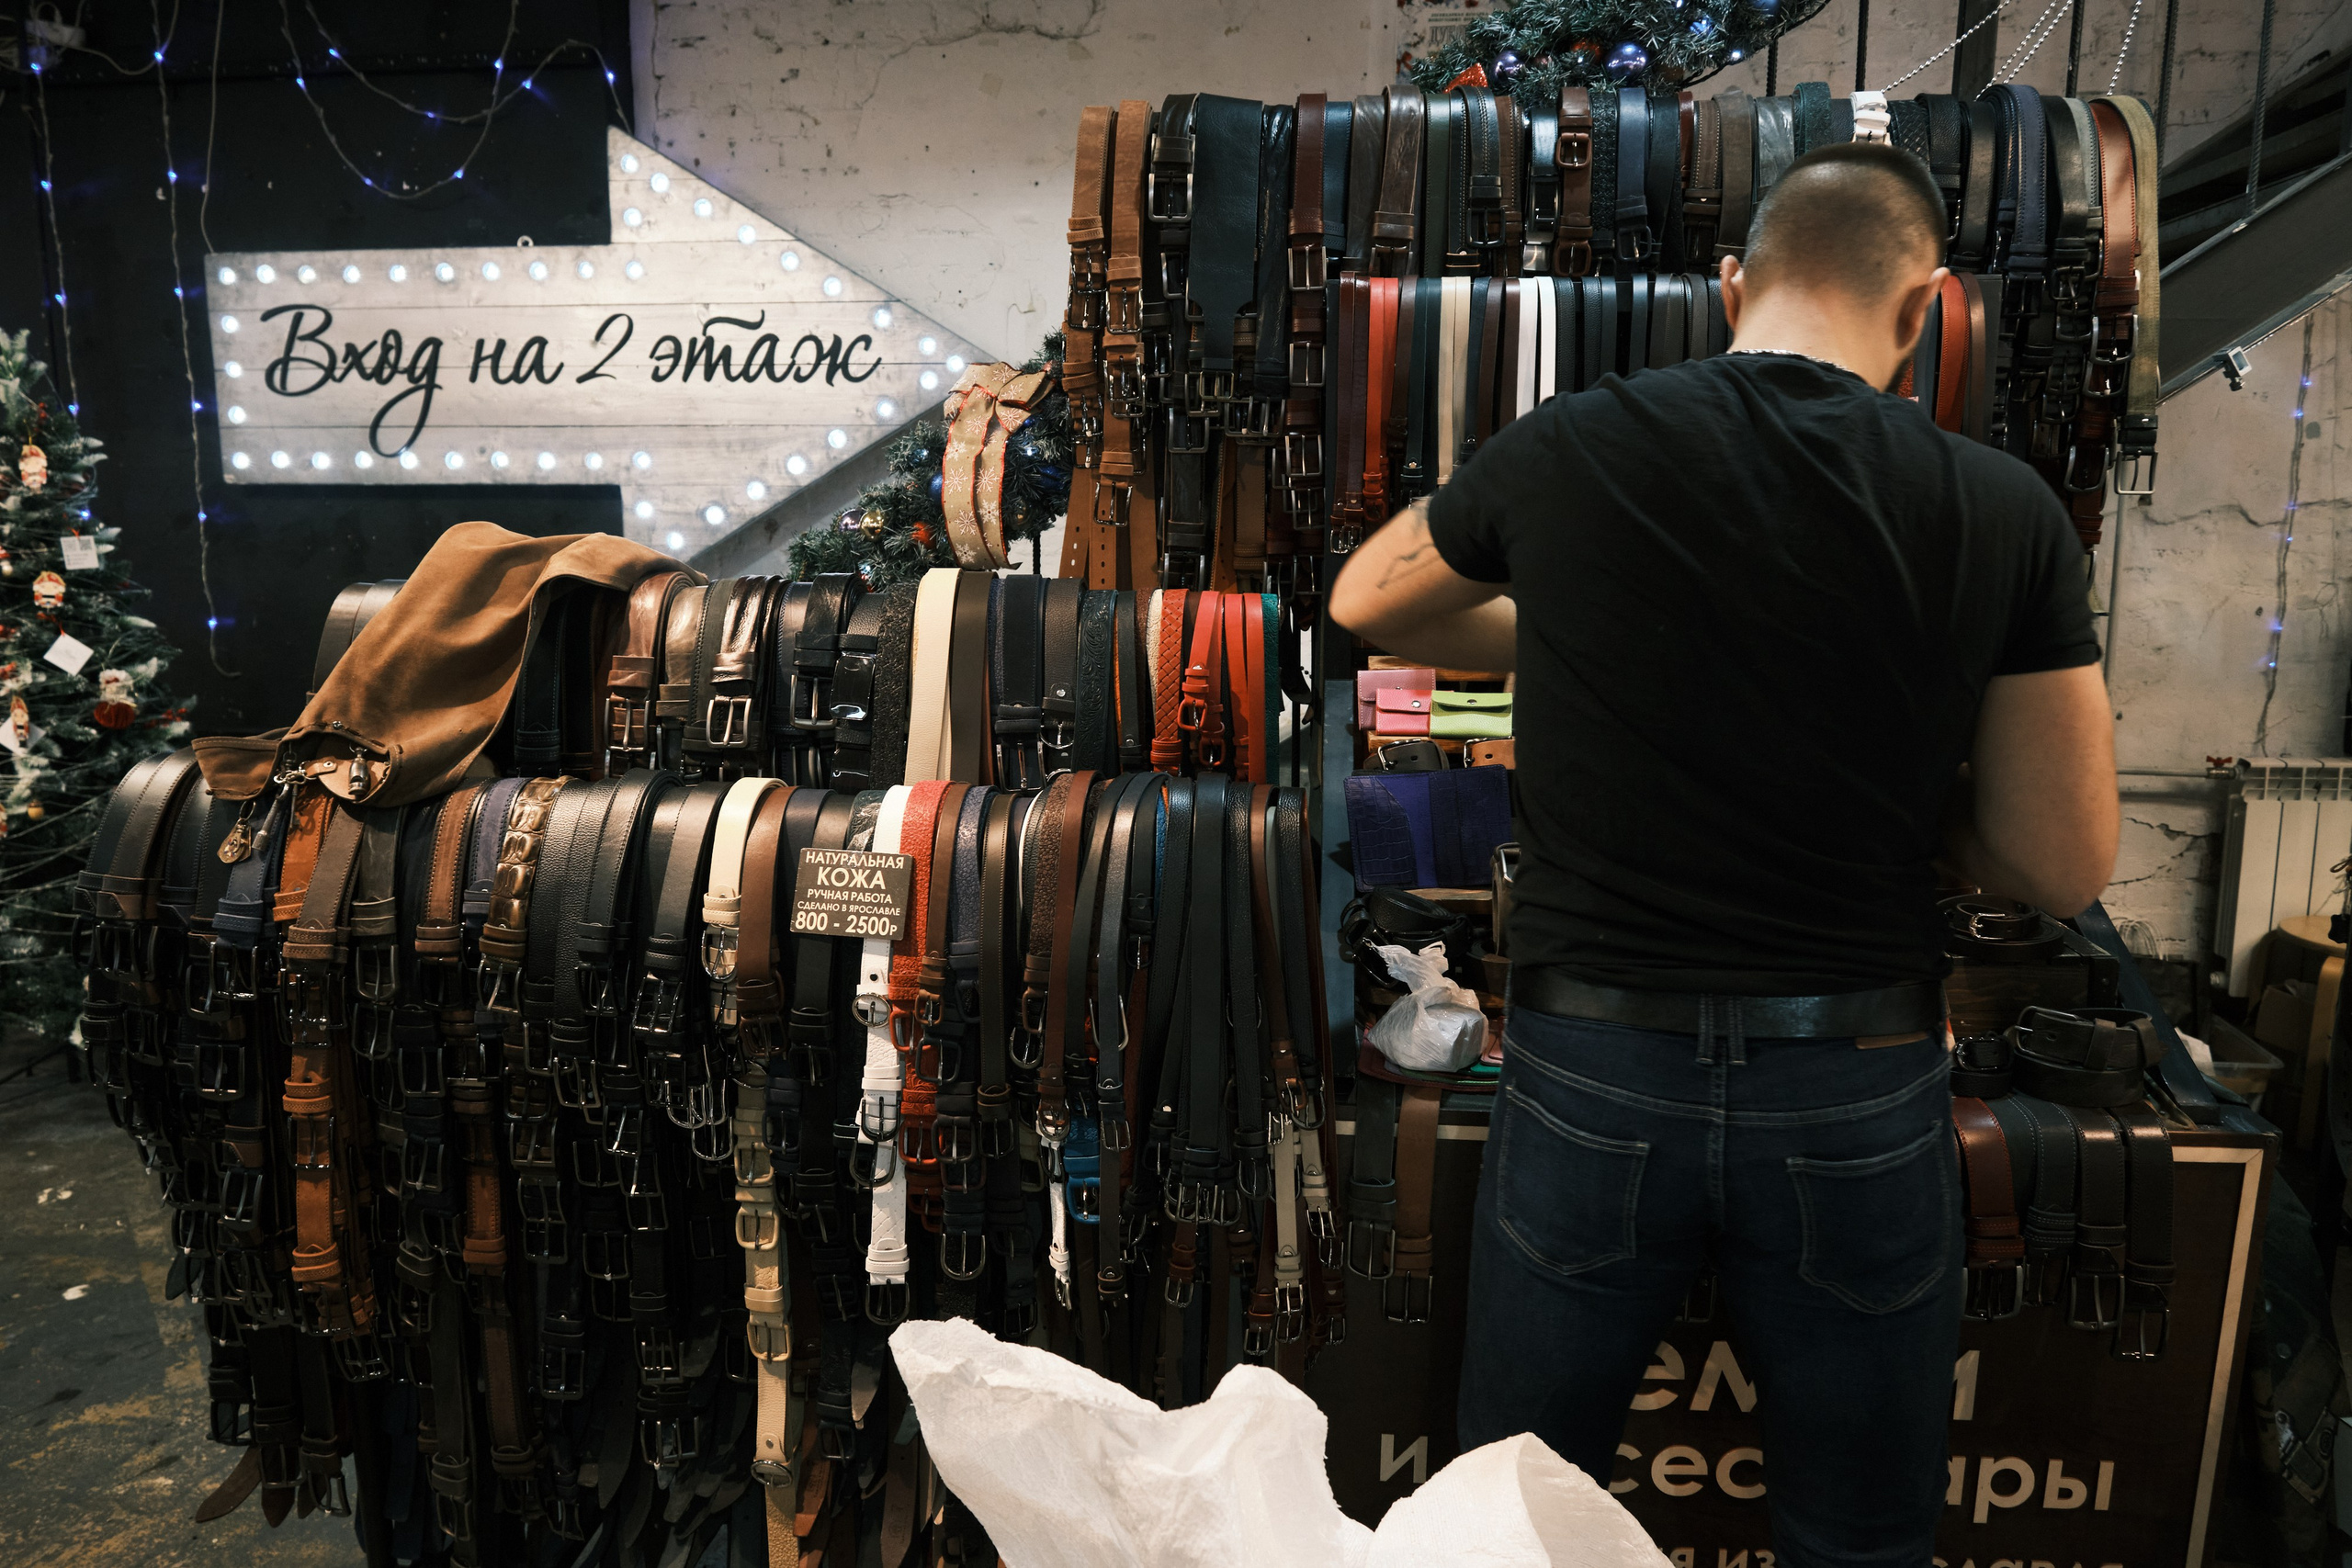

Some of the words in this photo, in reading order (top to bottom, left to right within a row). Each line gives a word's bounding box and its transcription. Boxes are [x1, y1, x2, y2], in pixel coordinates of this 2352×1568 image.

[260, 304, 443, 457] Вход
[469, 336, 564, 385] на
[576, 313, 633, 384] 2
[649, 310, 882, 387] этаж
[806, 851, 905, 869] НАТУРАЛЬНАЯ
[817, 866, 886, 890] КОЖА
[807, 888, 849, 901] РУЧНАЯ
[850, 891, 892, 904] РАБОТА
[797, 900, 840, 912] СДЕЛАНО
[842, 904, 847, 912] В
[848, 905, 900, 916] ЯРОСЛАВЛЕ
[795, 911, 828, 931] 800
[1380, 1434, 1428, 1483] и
